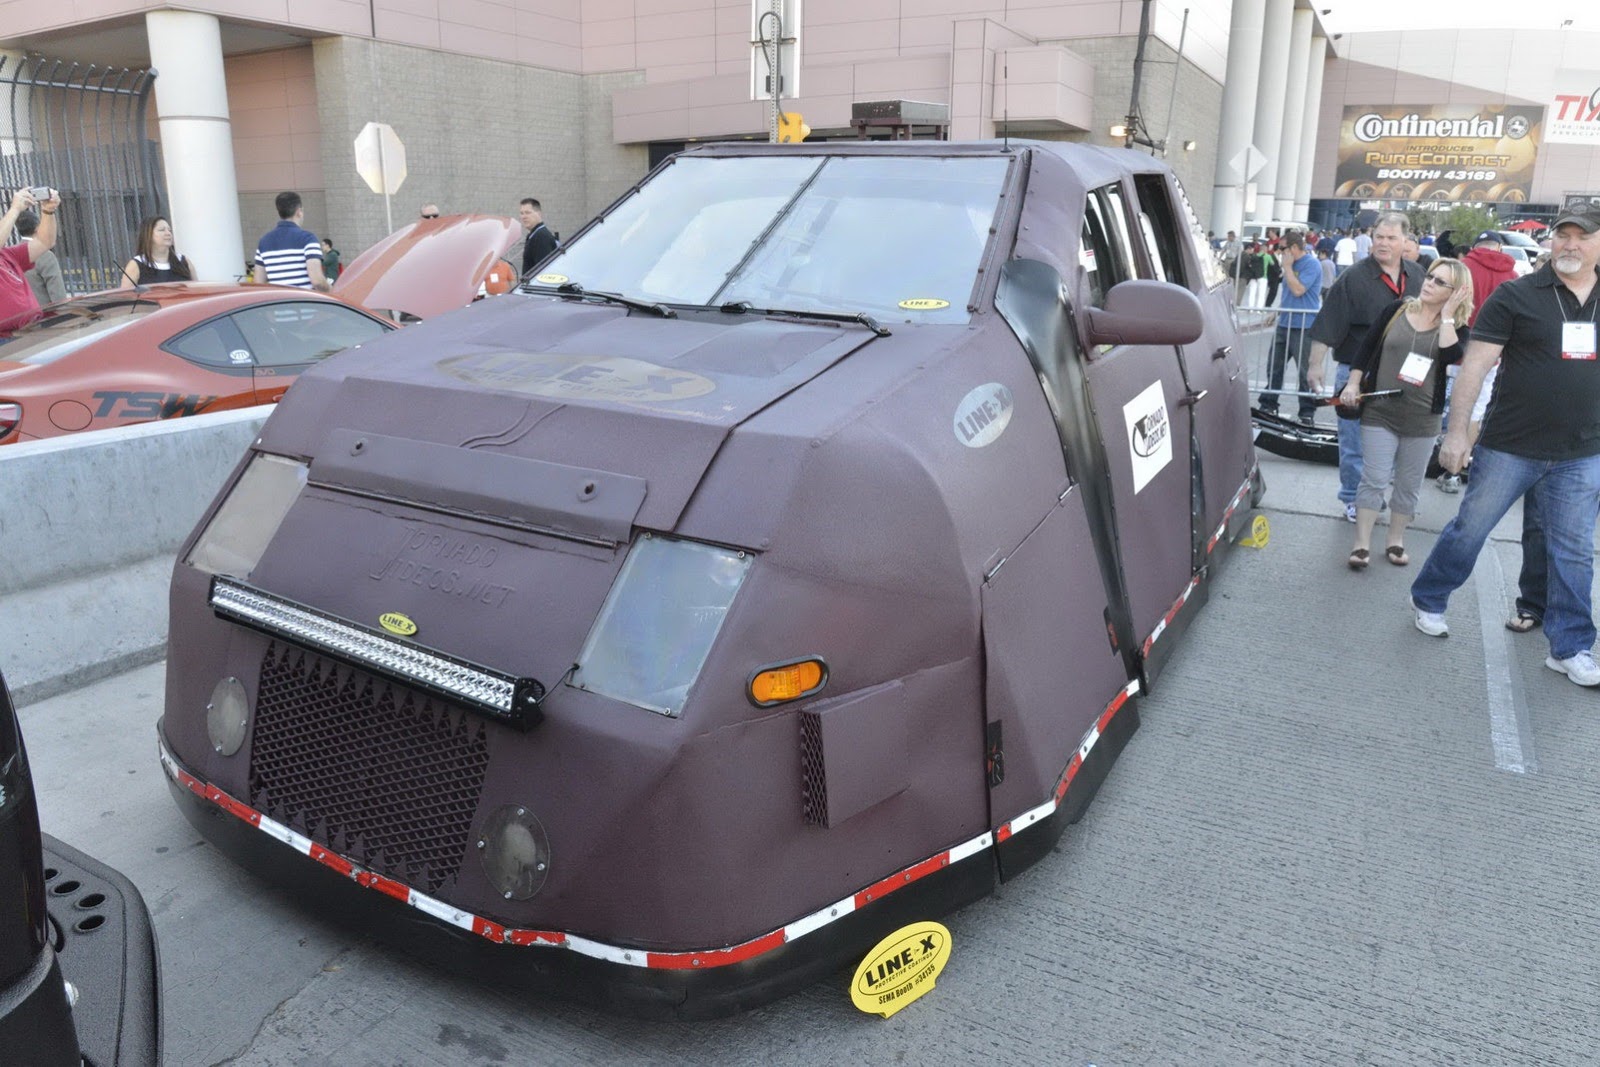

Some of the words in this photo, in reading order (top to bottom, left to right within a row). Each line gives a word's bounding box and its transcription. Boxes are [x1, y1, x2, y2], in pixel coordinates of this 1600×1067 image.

[1354, 113, 1504, 142] Continental
[1377, 169, 1440, 180] BOOTH#
[1444, 170, 1496, 181] 43169
[92, 390, 218, 419] TSW
[875, 968, 907, 991] PROTECTIVE
[908, 952, 933, 970] COATINGS
[878, 993, 896, 1005] SEMA
[896, 982, 914, 998] Booth
